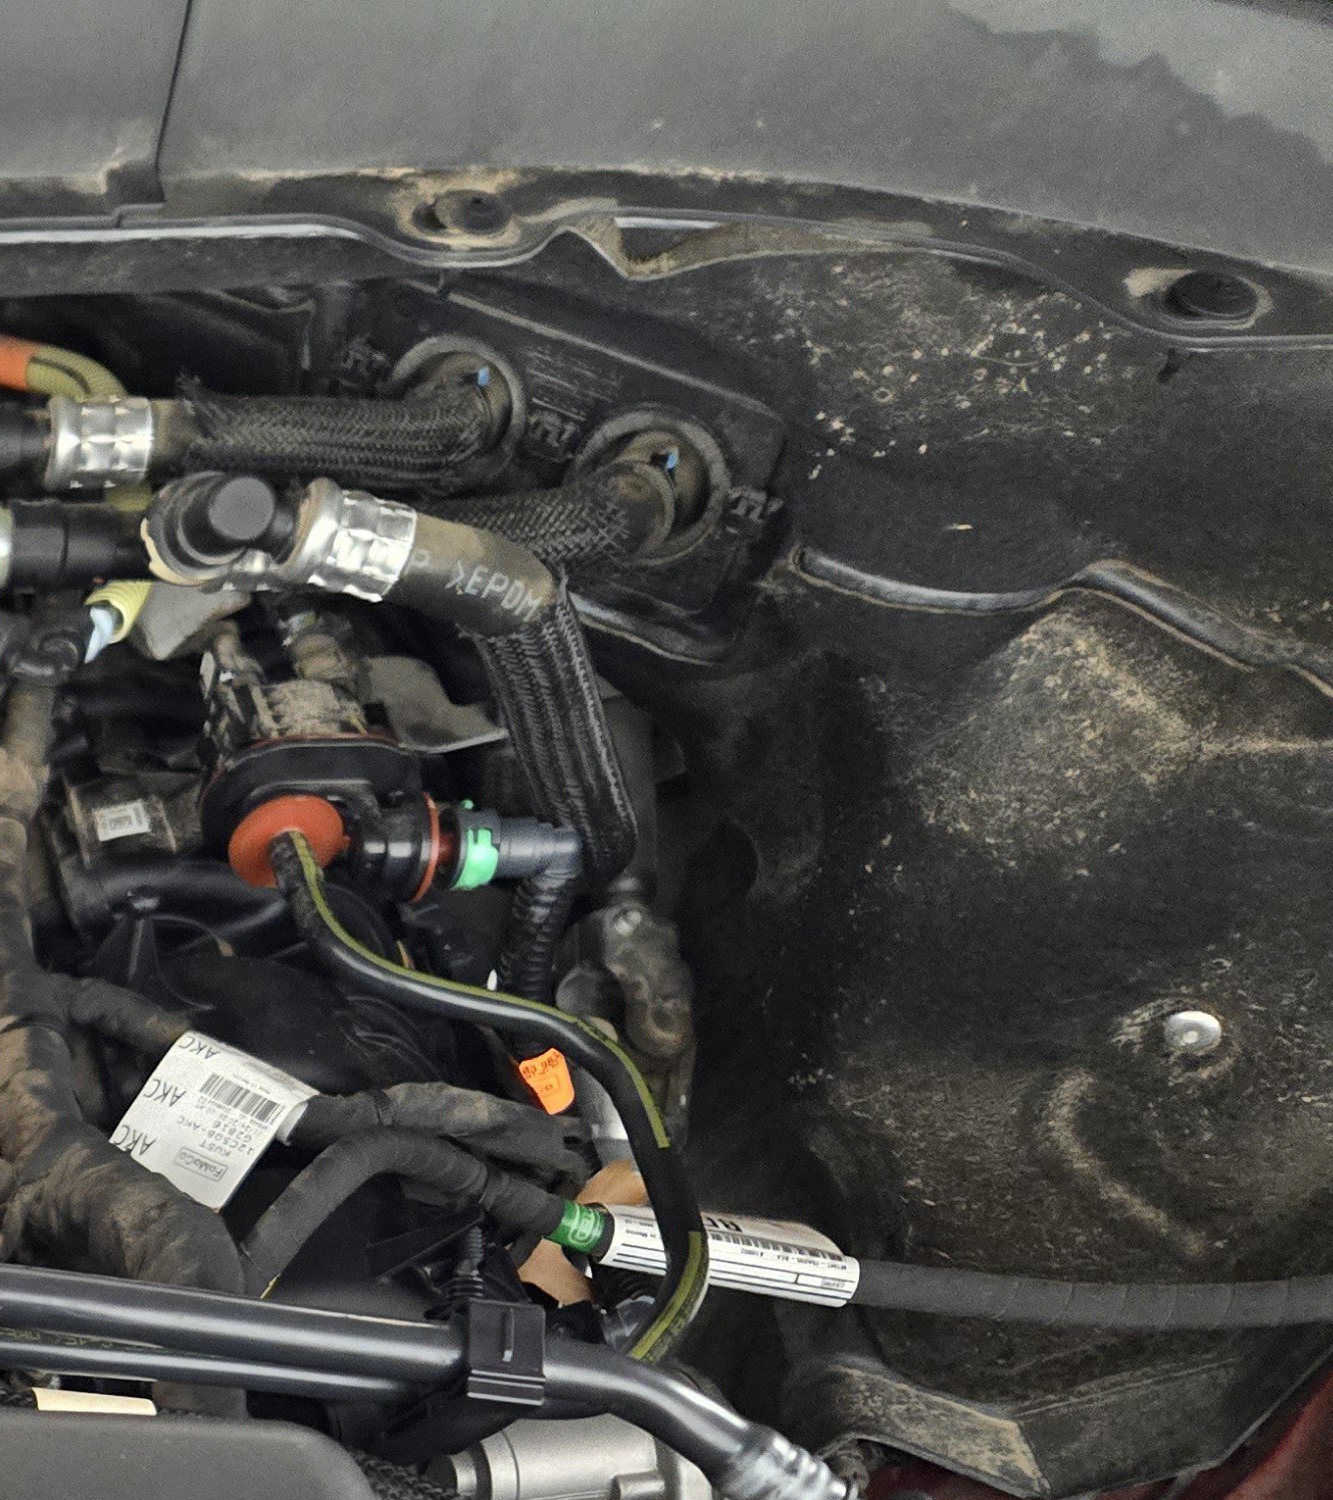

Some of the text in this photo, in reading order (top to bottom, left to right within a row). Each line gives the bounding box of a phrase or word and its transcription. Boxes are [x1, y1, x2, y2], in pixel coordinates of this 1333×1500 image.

[176, 1035, 220, 1061] AKC
[142, 1076, 186, 1108] AKC
[112, 1123, 157, 1157] AKC
[197, 1138, 231, 1158] KUST
[176, 1150, 223, 1178] FoMoCo
